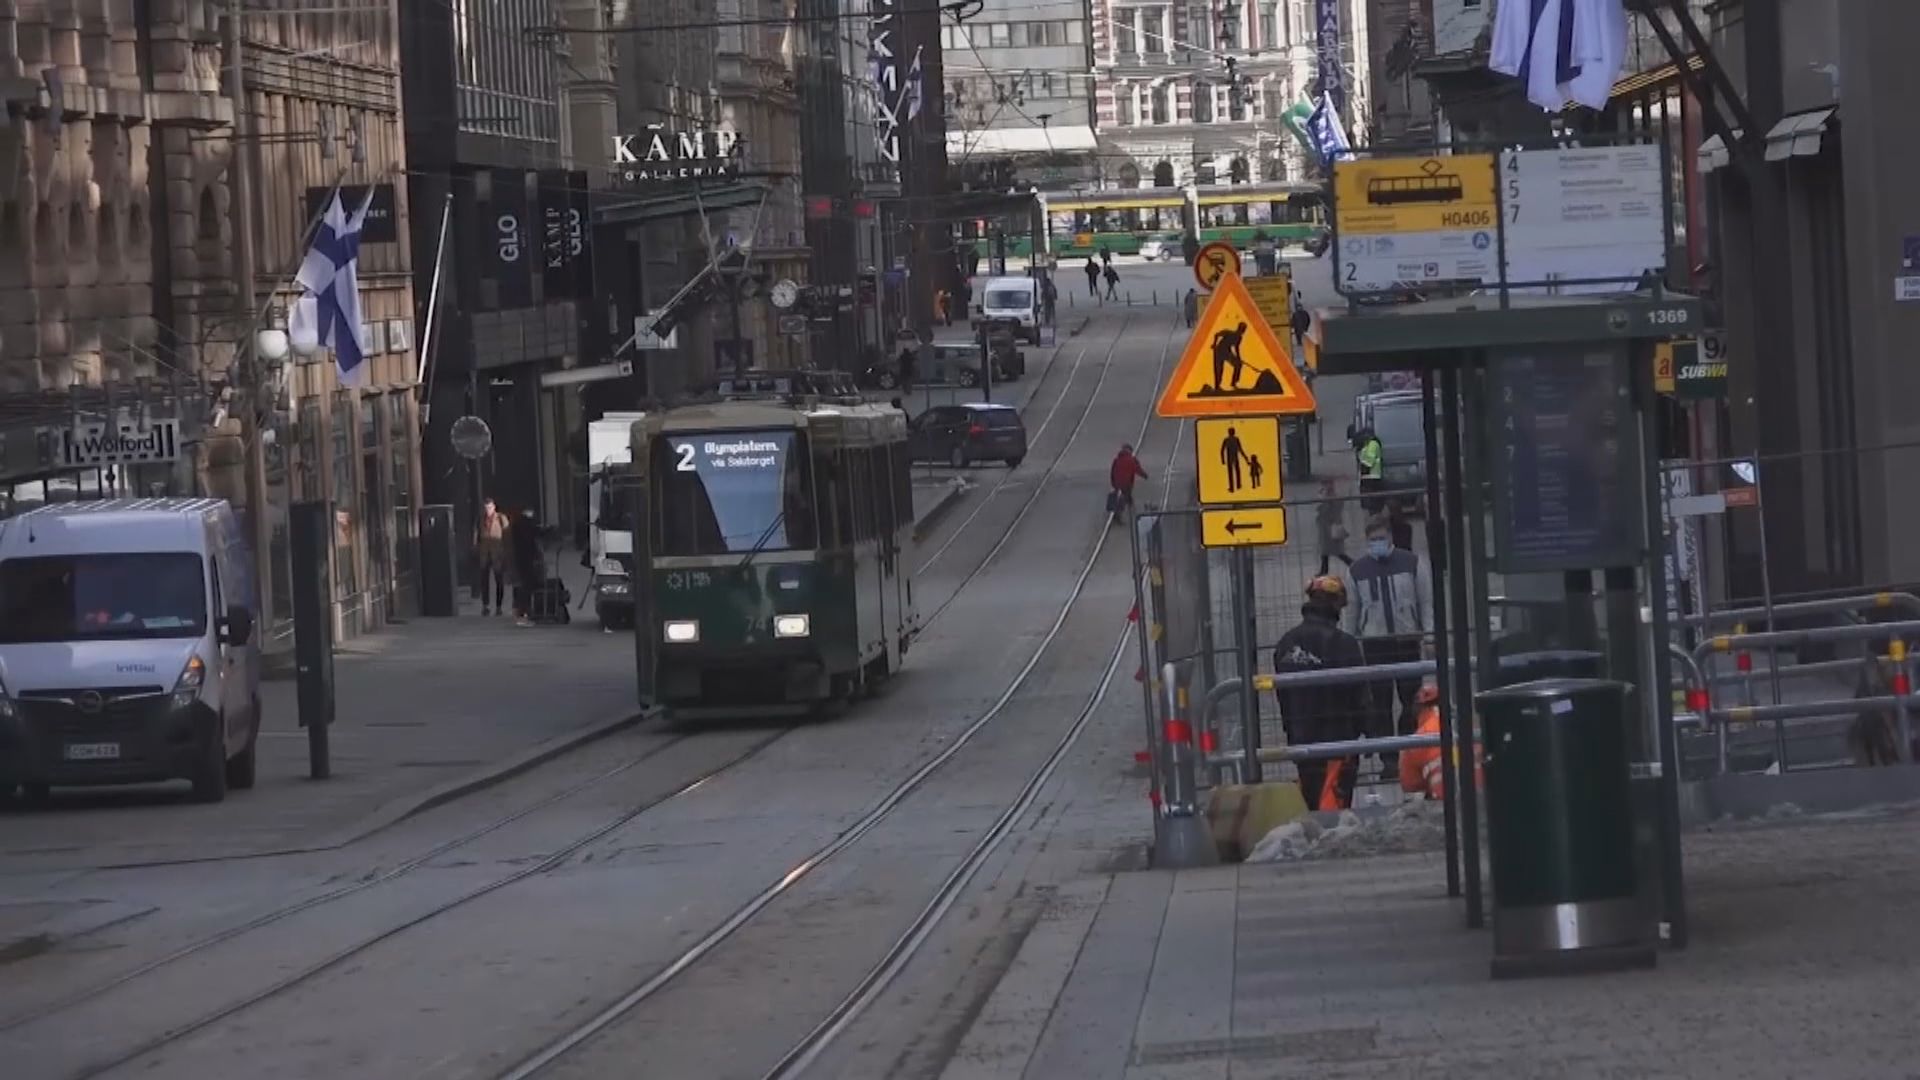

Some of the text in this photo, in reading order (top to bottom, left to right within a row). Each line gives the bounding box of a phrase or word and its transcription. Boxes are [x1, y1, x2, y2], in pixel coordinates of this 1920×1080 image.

[1507, 155, 1519, 173] 4
[1509, 180, 1519, 199] 5
[1442, 210, 1490, 227] H0406
[1510, 204, 1520, 224] 7
[497, 215, 519, 262] GLO
[1345, 262, 1357, 281] 2
[1648, 309, 1688, 324] 1369
[1677, 362, 1728, 380] SUBWA
[84, 432, 155, 454] Wolford
[704, 440, 780, 455] Olympiaterm.
[676, 443, 697, 471] 2
